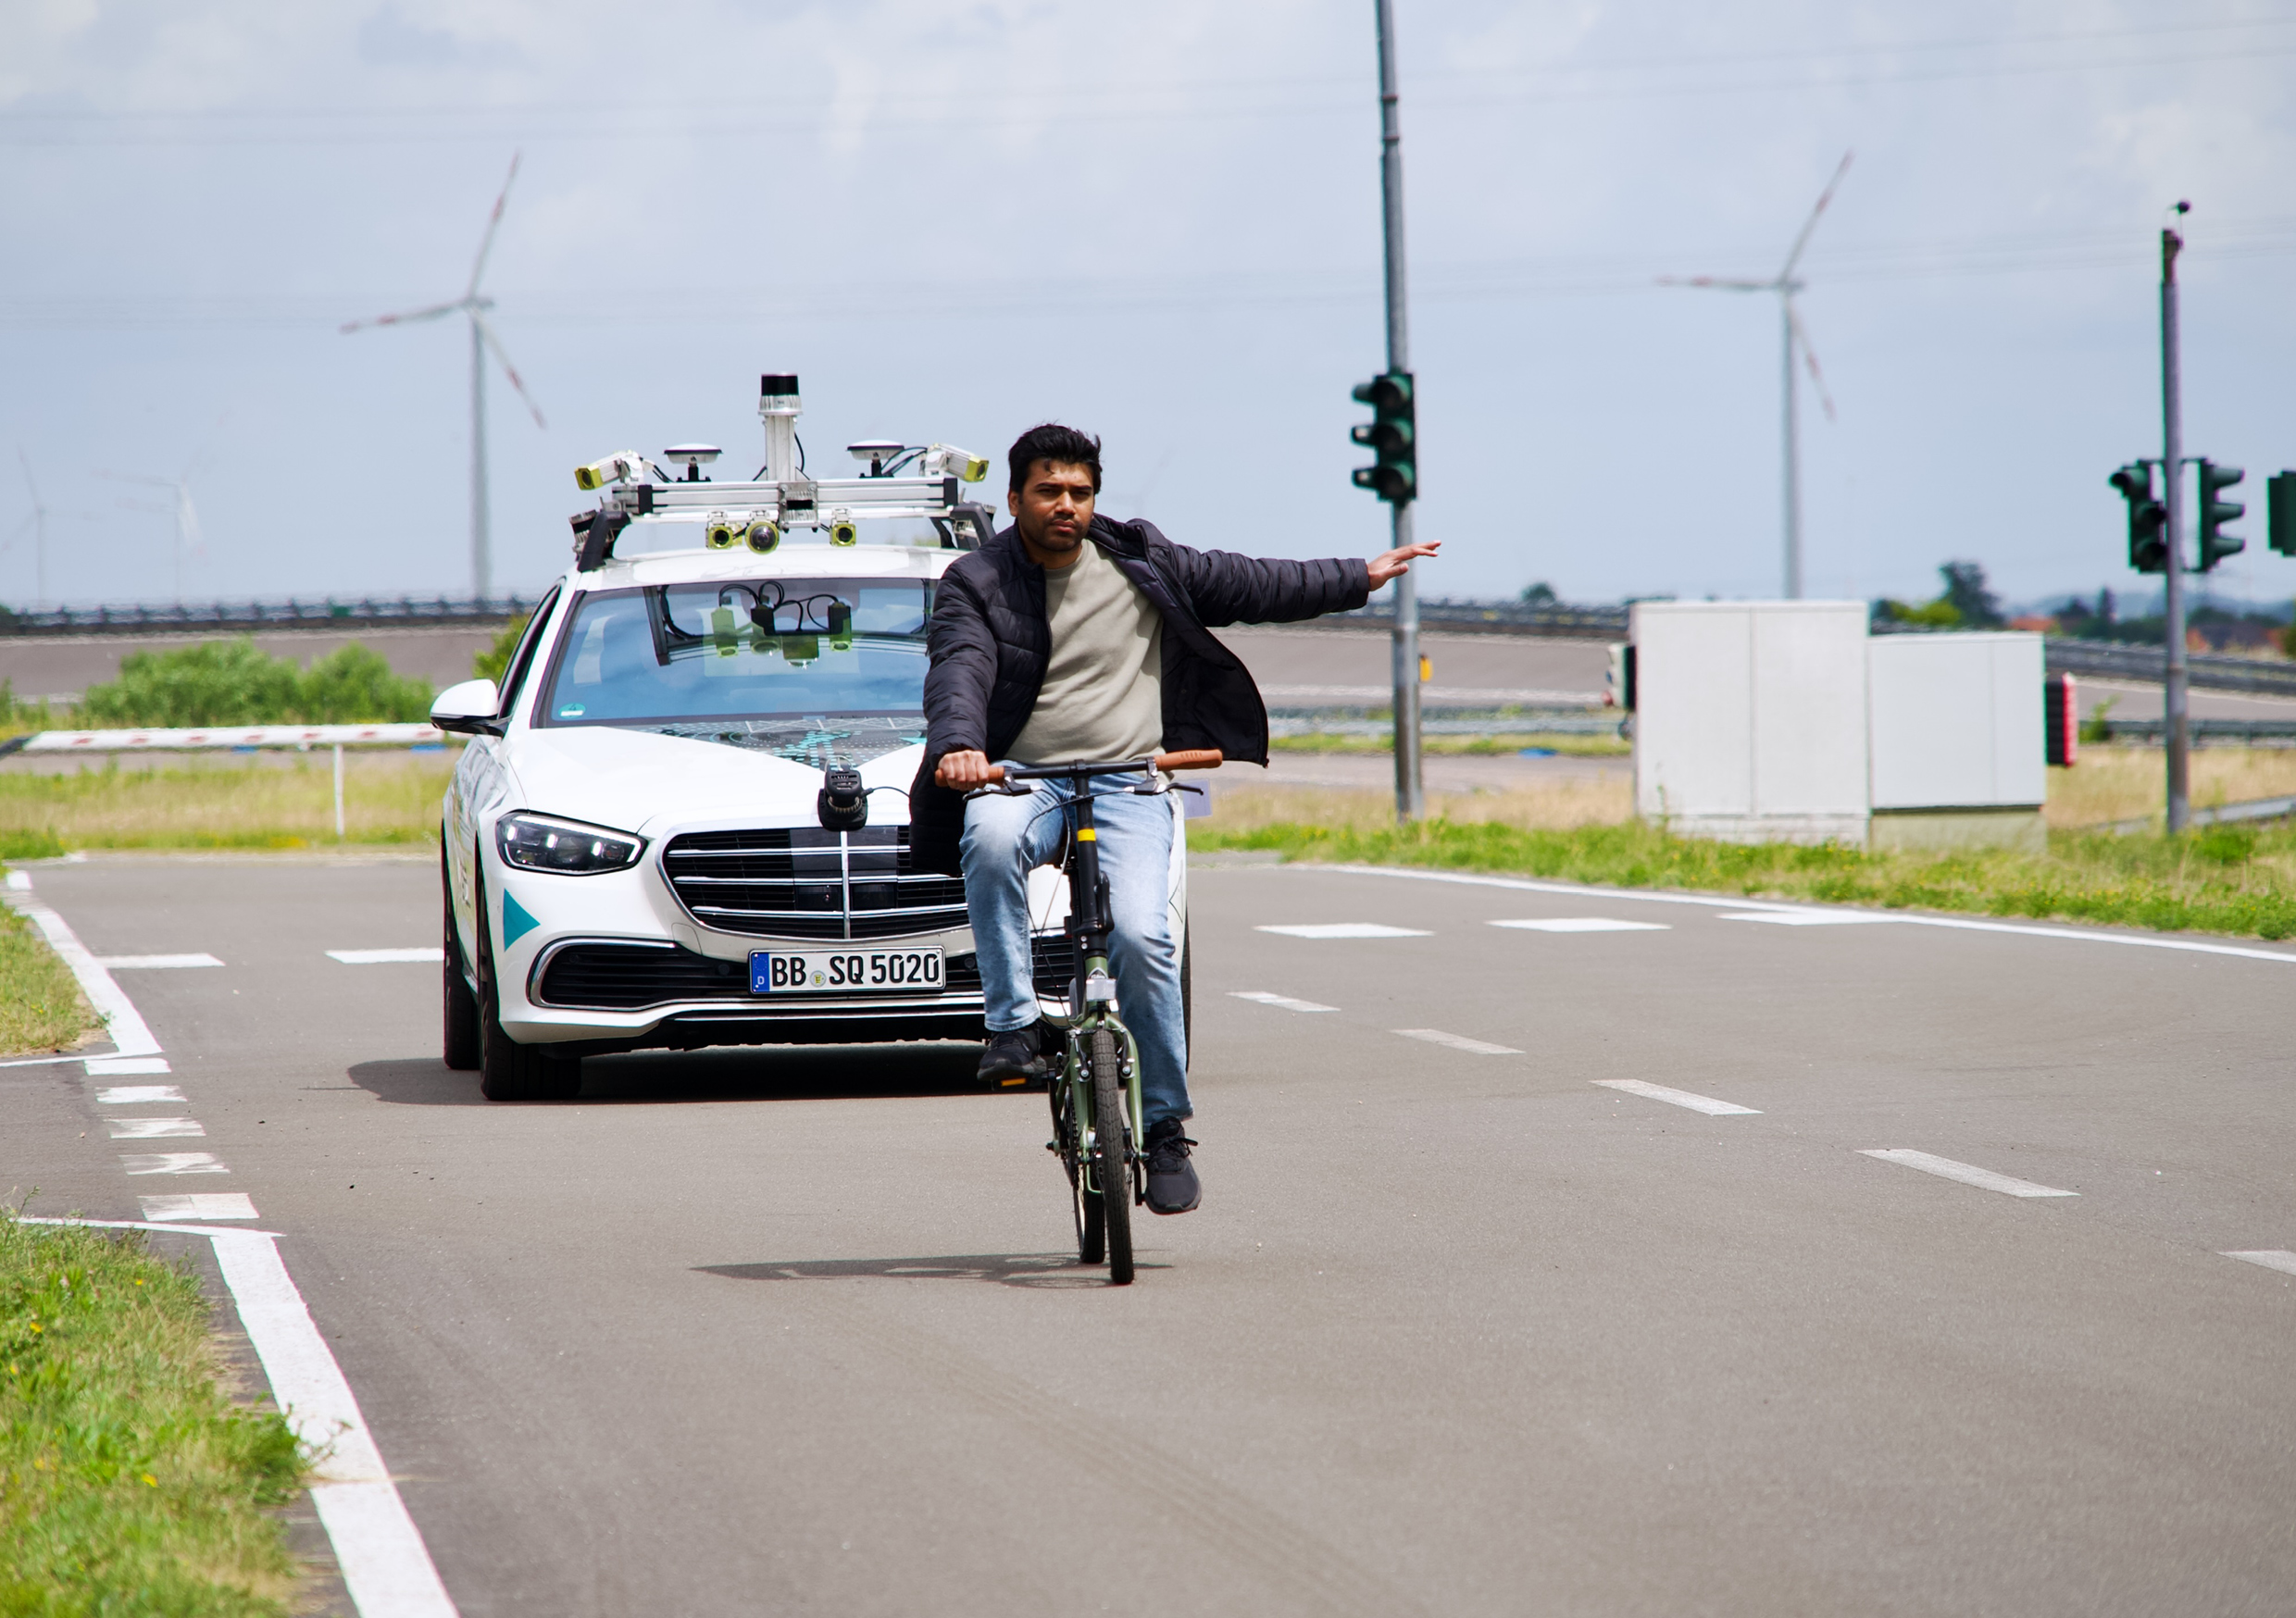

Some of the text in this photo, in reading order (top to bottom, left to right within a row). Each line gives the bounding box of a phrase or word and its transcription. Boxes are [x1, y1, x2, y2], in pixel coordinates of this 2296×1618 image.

[757, 976, 765, 985] D
[771, 953, 939, 987] BB SQ 5020
